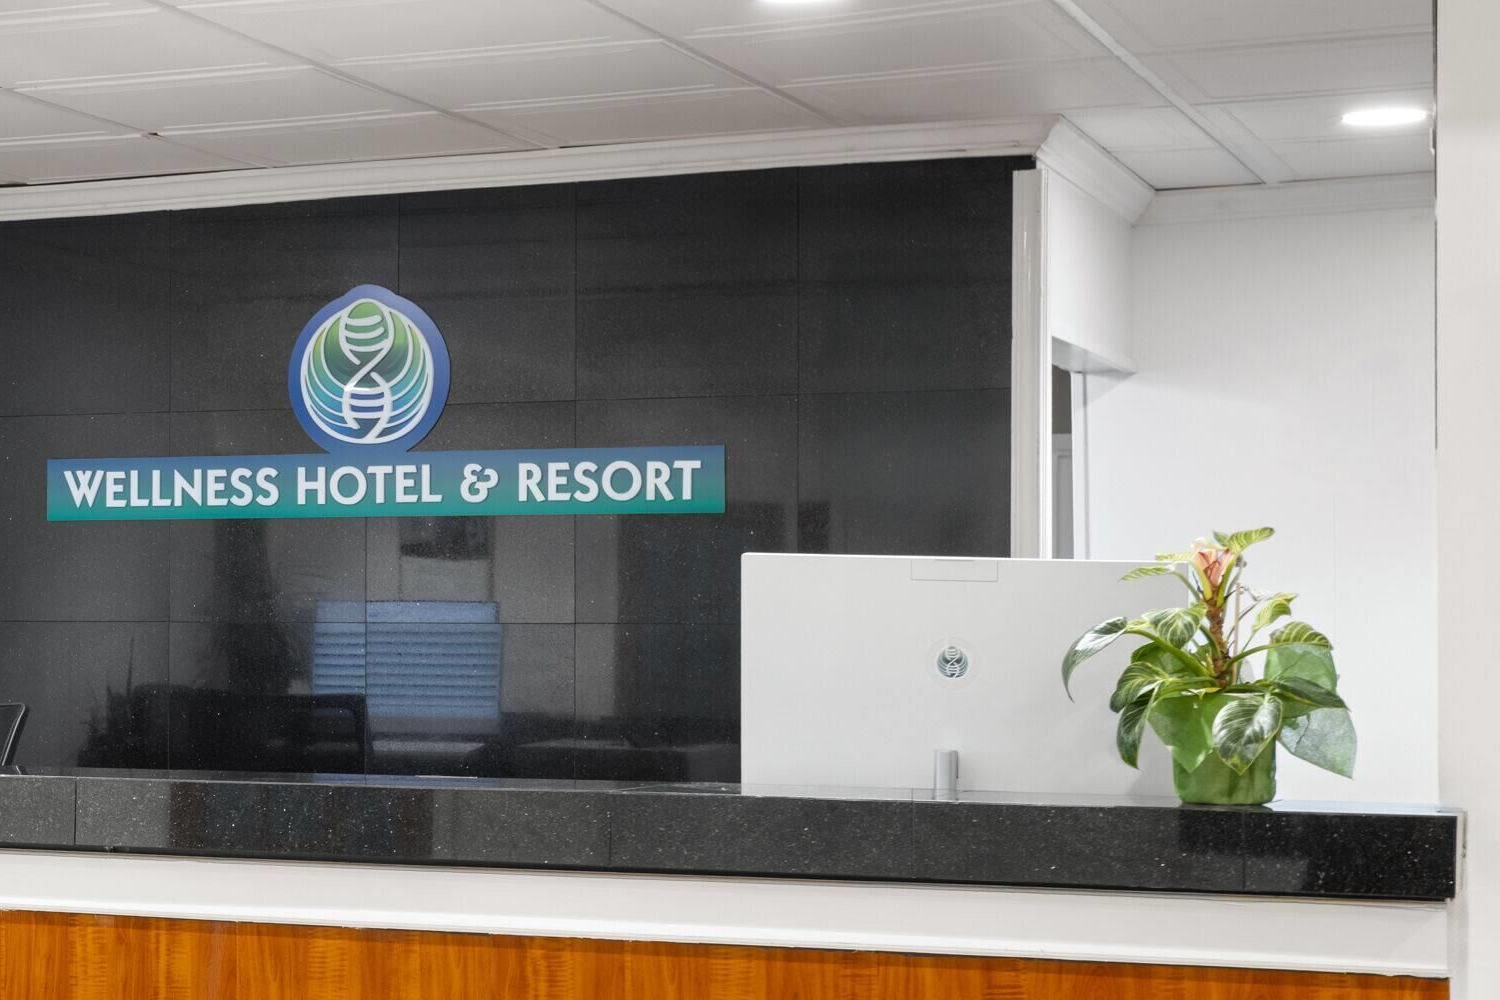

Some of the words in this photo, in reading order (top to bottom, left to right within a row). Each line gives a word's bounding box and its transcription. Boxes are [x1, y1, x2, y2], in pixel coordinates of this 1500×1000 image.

[63, 467, 279, 508] WELLNESS
[296, 463, 443, 505] HOTEL
[460, 462, 499, 503] &
[517, 459, 702, 502] RESORT
